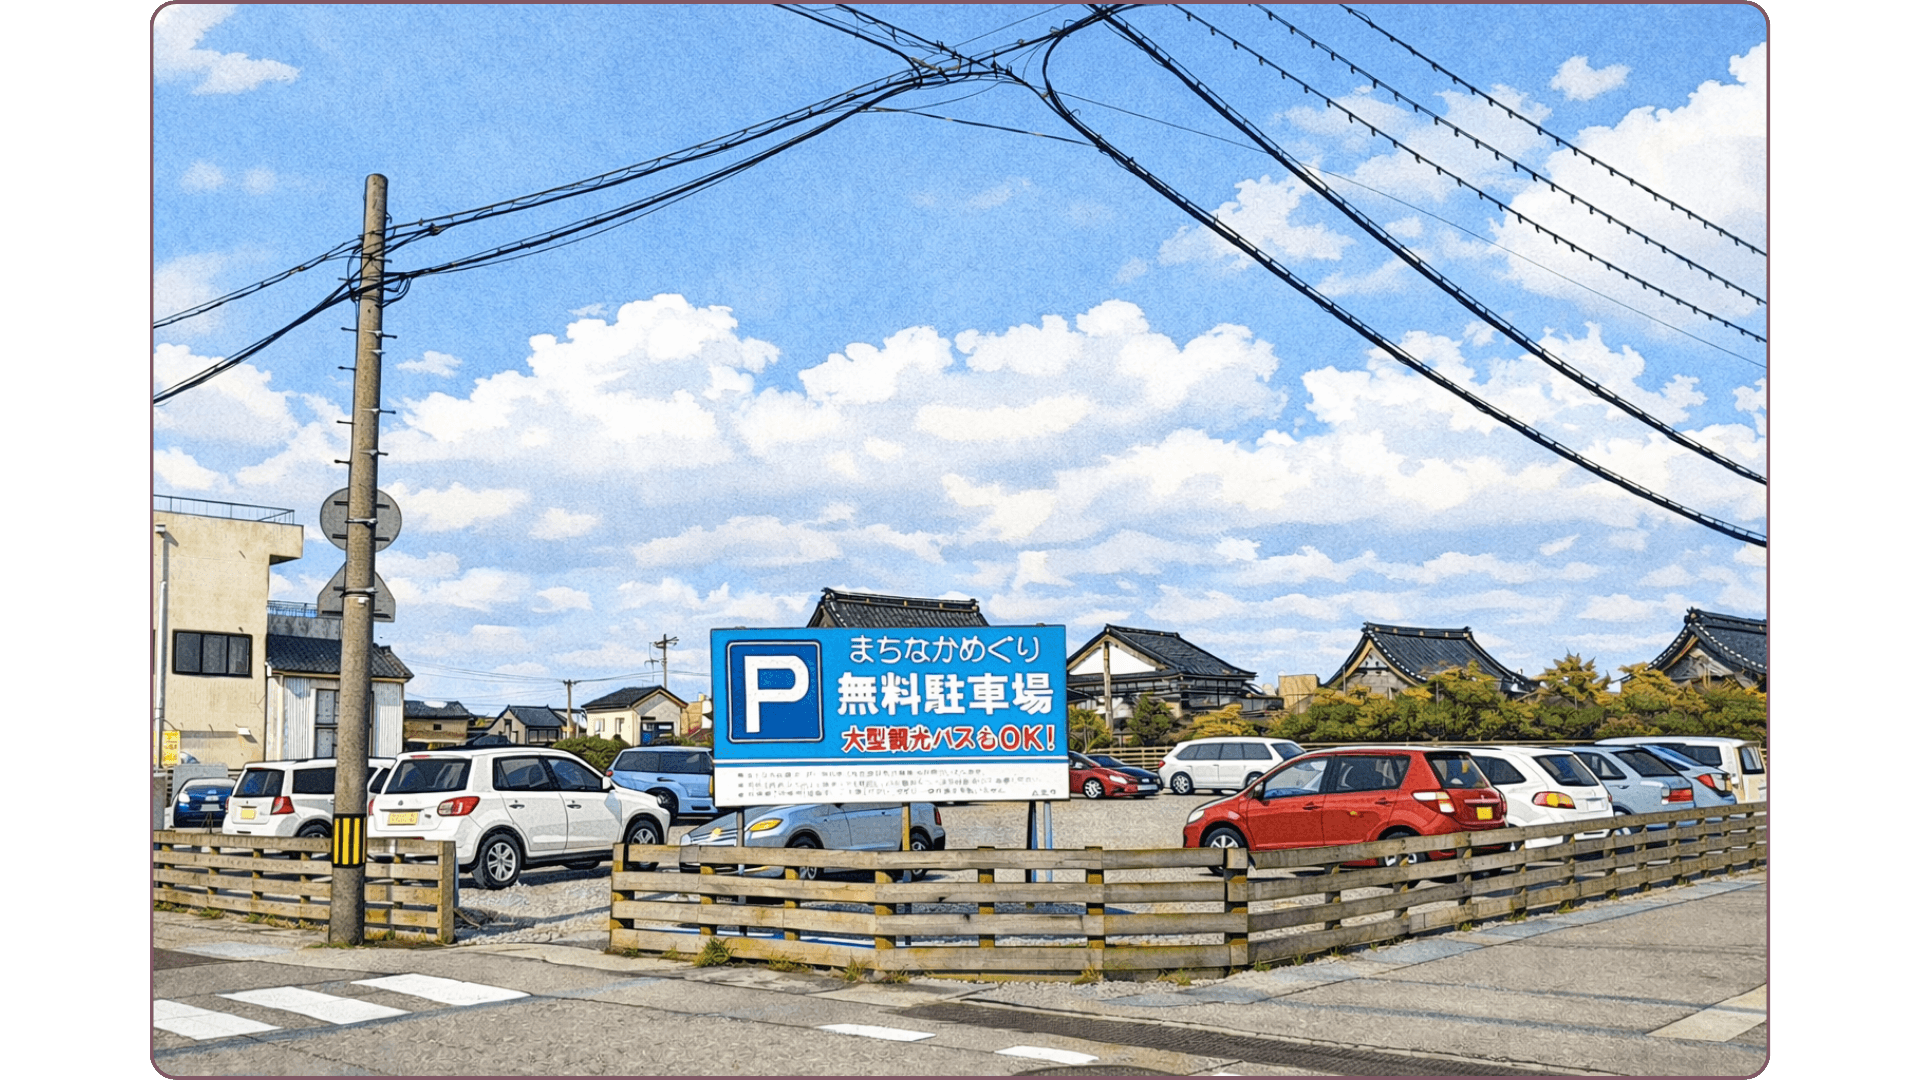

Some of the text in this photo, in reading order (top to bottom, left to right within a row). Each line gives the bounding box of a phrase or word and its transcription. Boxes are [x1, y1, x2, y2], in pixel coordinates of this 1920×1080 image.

[849, 634, 1040, 664] まちなかめぐり
[744, 655, 810, 733] P
[837, 671, 1054, 716] 無料駐車場
